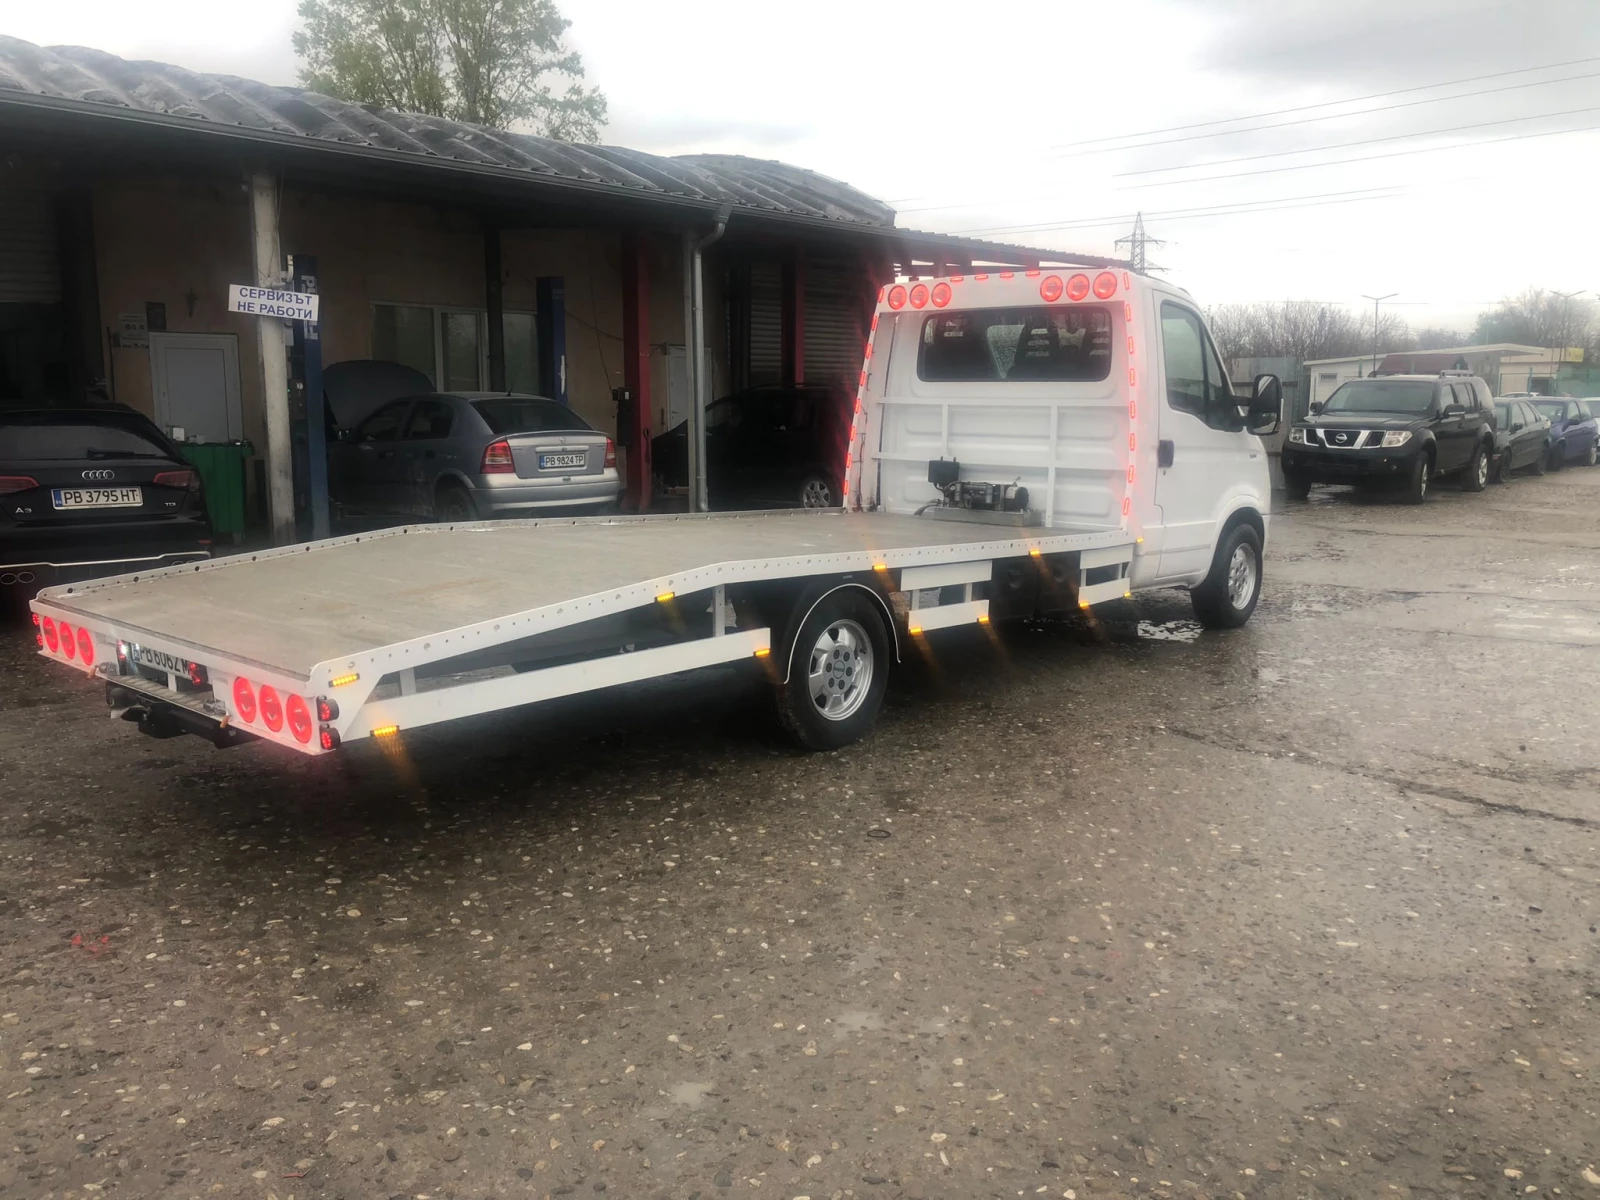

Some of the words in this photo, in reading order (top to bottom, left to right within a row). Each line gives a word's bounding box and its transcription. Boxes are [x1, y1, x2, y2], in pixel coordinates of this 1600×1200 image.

[239, 287, 312, 305] СЕРВИЗЪТ
[237, 301, 255, 312] НЕ
[259, 303, 312, 319] РАБОТИ
[545, 457, 555, 466] PB
[557, 456, 574, 465] 9824
[575, 455, 584, 464] TP
[64, 491, 83, 504] PB
[86, 489, 119, 503] 3795
[121, 489, 137, 502] HT
